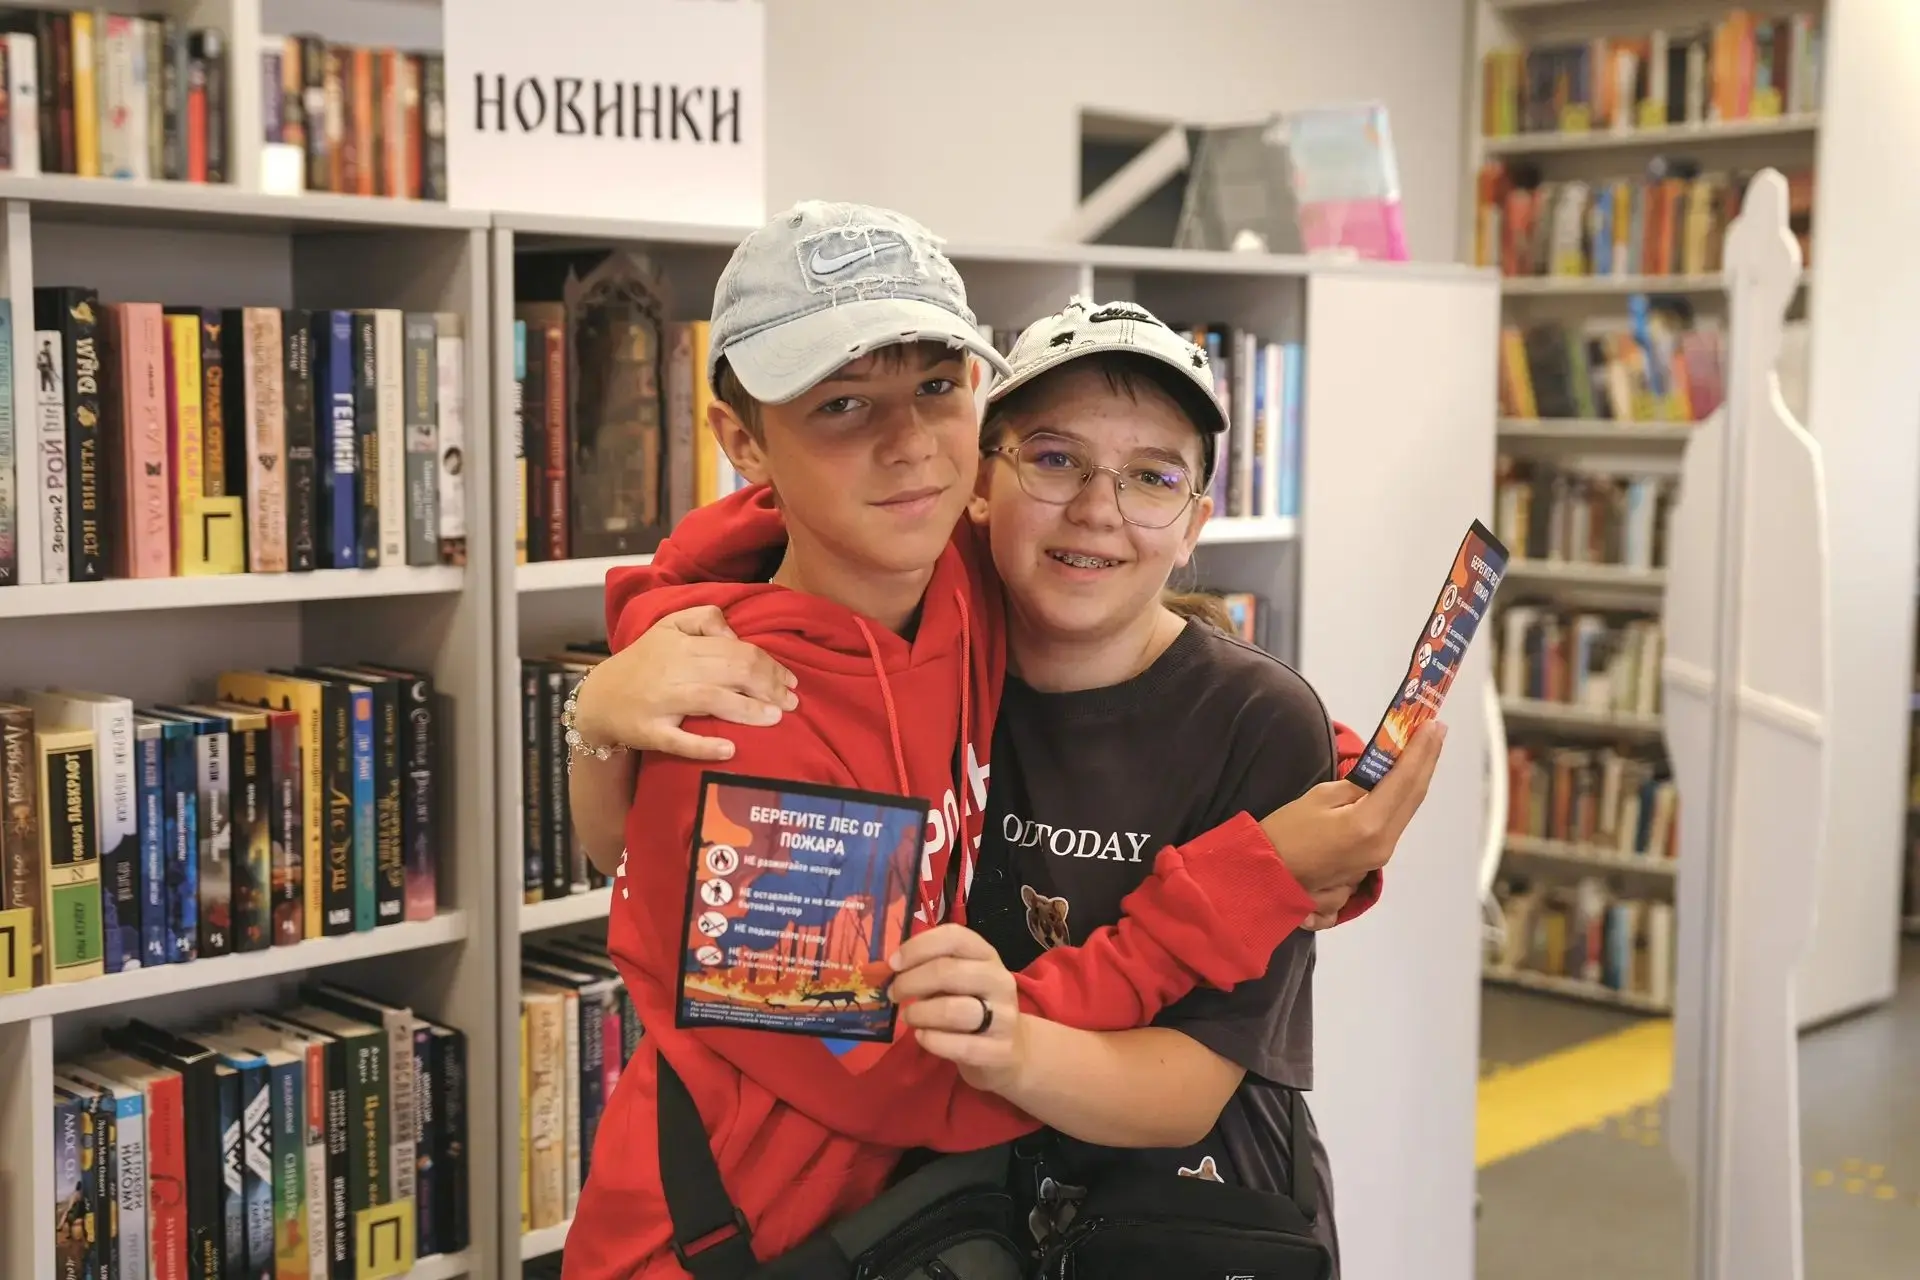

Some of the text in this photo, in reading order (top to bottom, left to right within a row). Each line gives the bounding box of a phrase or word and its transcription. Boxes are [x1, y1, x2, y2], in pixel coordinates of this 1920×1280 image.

[475, 73, 741, 144] НОВИНКИ
[39, 439, 64, 489] РОЙ
[49, 495, 62, 504] 2
[81, 439, 99, 557] ДЭН ВИЛЕТА
[203, 512, 231, 562] Г
[65, 754, 83, 823] ЛАВКРАФТ
[750, 806, 883, 838] БЕРЕГИТЕ ЛЕС ОТ
[780, 832, 845, 856] ПОЖАРА
[744, 855, 757, 866] НЕ
[757, 859, 808, 873] разжигайте
[738, 900, 802, 917] бытовой мусор
[739, 887, 752, 898] НЕ
[753, 890, 801, 904] оставляйте
[734, 923, 747, 933] НЕ
[748, 927, 800, 941] поджигайте
[728, 946, 741, 957] НЕ
[64, 1113, 76, 1151] АМОС
[121, 1144, 135, 1211] НИКОМУ
[370, 1216, 400, 1269] П
